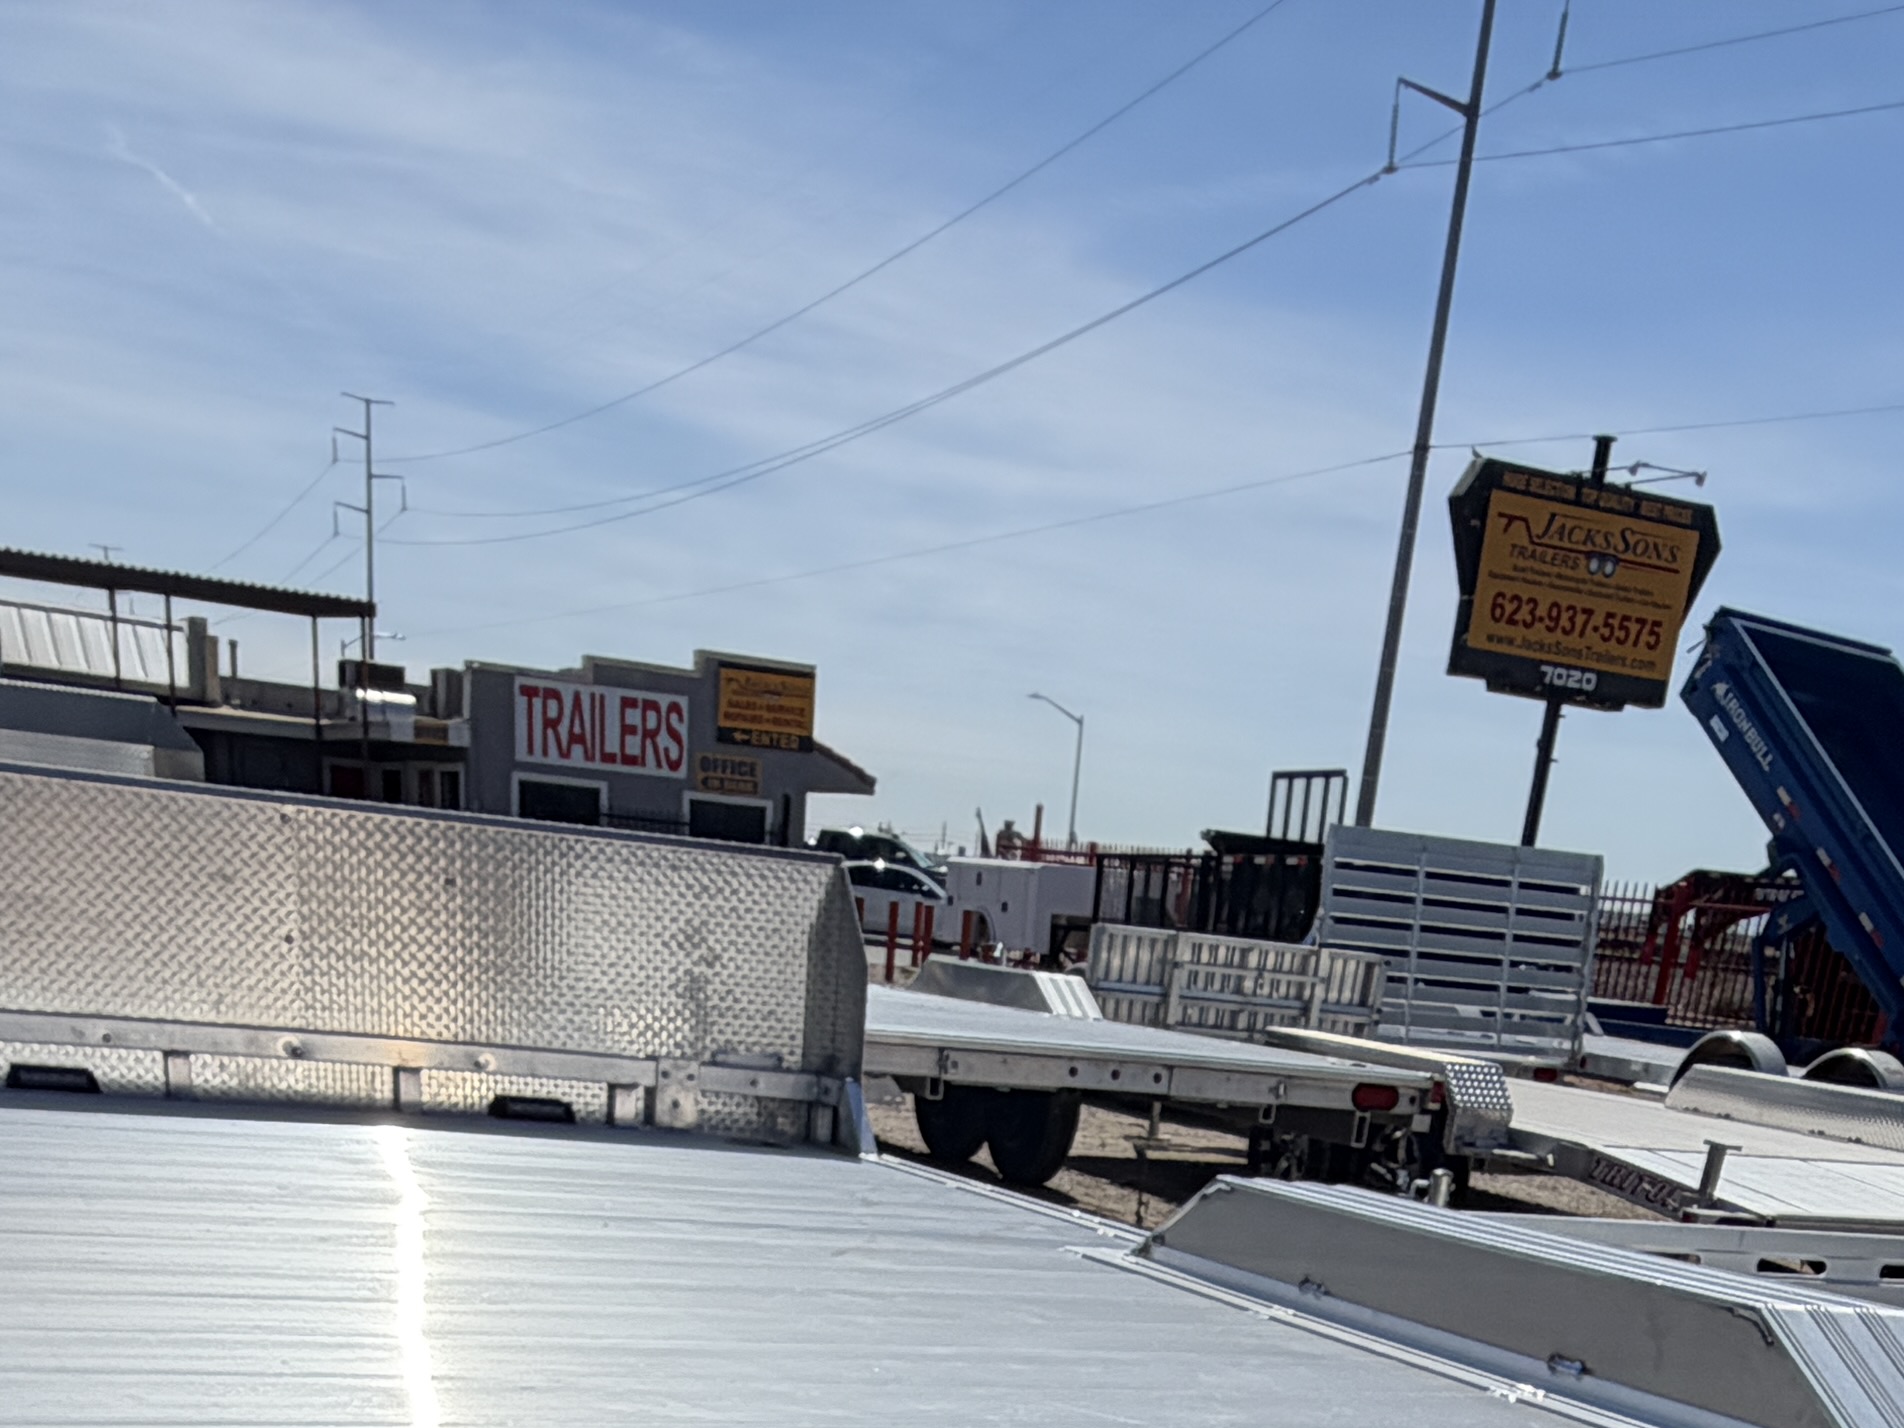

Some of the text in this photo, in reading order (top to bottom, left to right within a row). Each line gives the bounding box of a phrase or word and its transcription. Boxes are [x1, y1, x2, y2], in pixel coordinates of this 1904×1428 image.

[1509, 543, 1581, 570] TRAILERS
[1490, 591, 1664, 651] 623-937-5575
[1540, 665, 1597, 691] 7020
[519, 684, 684, 772] TRAILERS
[751, 730, 800, 750] ENTER
[700, 755, 758, 778] OFFICE
